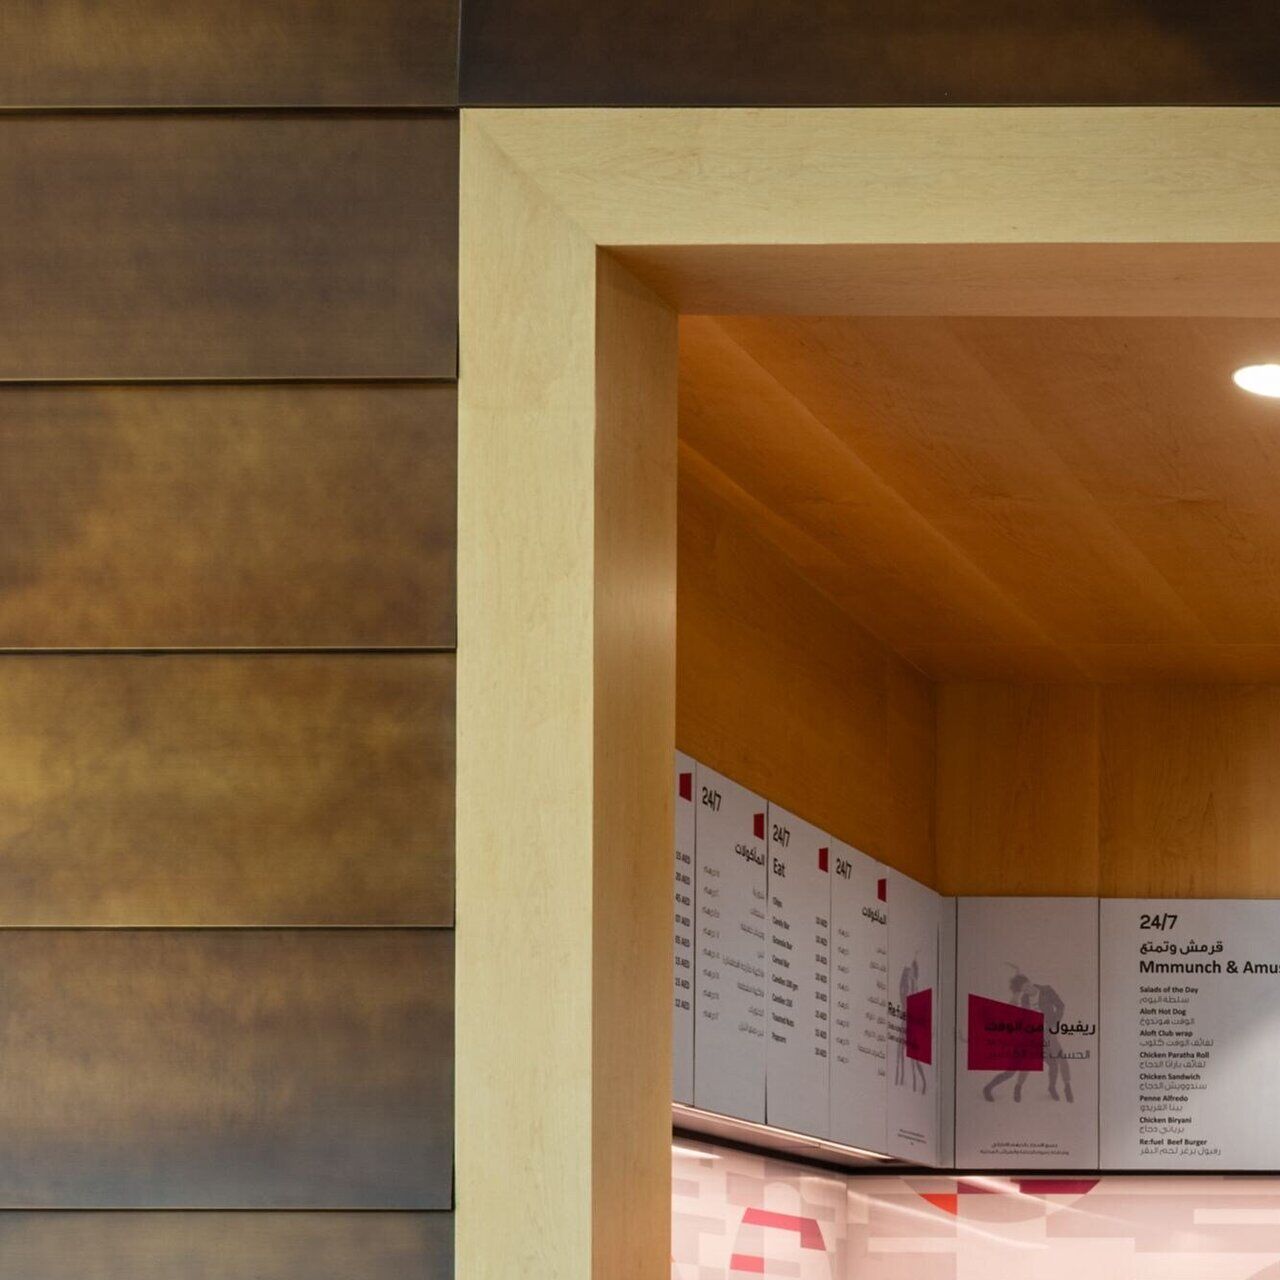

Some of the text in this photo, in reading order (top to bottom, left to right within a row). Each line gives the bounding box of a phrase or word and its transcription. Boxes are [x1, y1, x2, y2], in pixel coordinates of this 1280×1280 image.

[702, 786, 721, 811] 24/7
[773, 824, 790, 847] 24/7
[773, 858, 786, 877] Eat
[836, 858, 852, 879] 24/7
[1139, 912, 1179, 932] 24/7
[1139, 939, 1224, 956] قرمش وتمتع
[1139, 960, 1222, 975] Mmmunch
[1226, 960, 1239, 975] &
[1049, 1020, 1096, 1036] ريفيول
